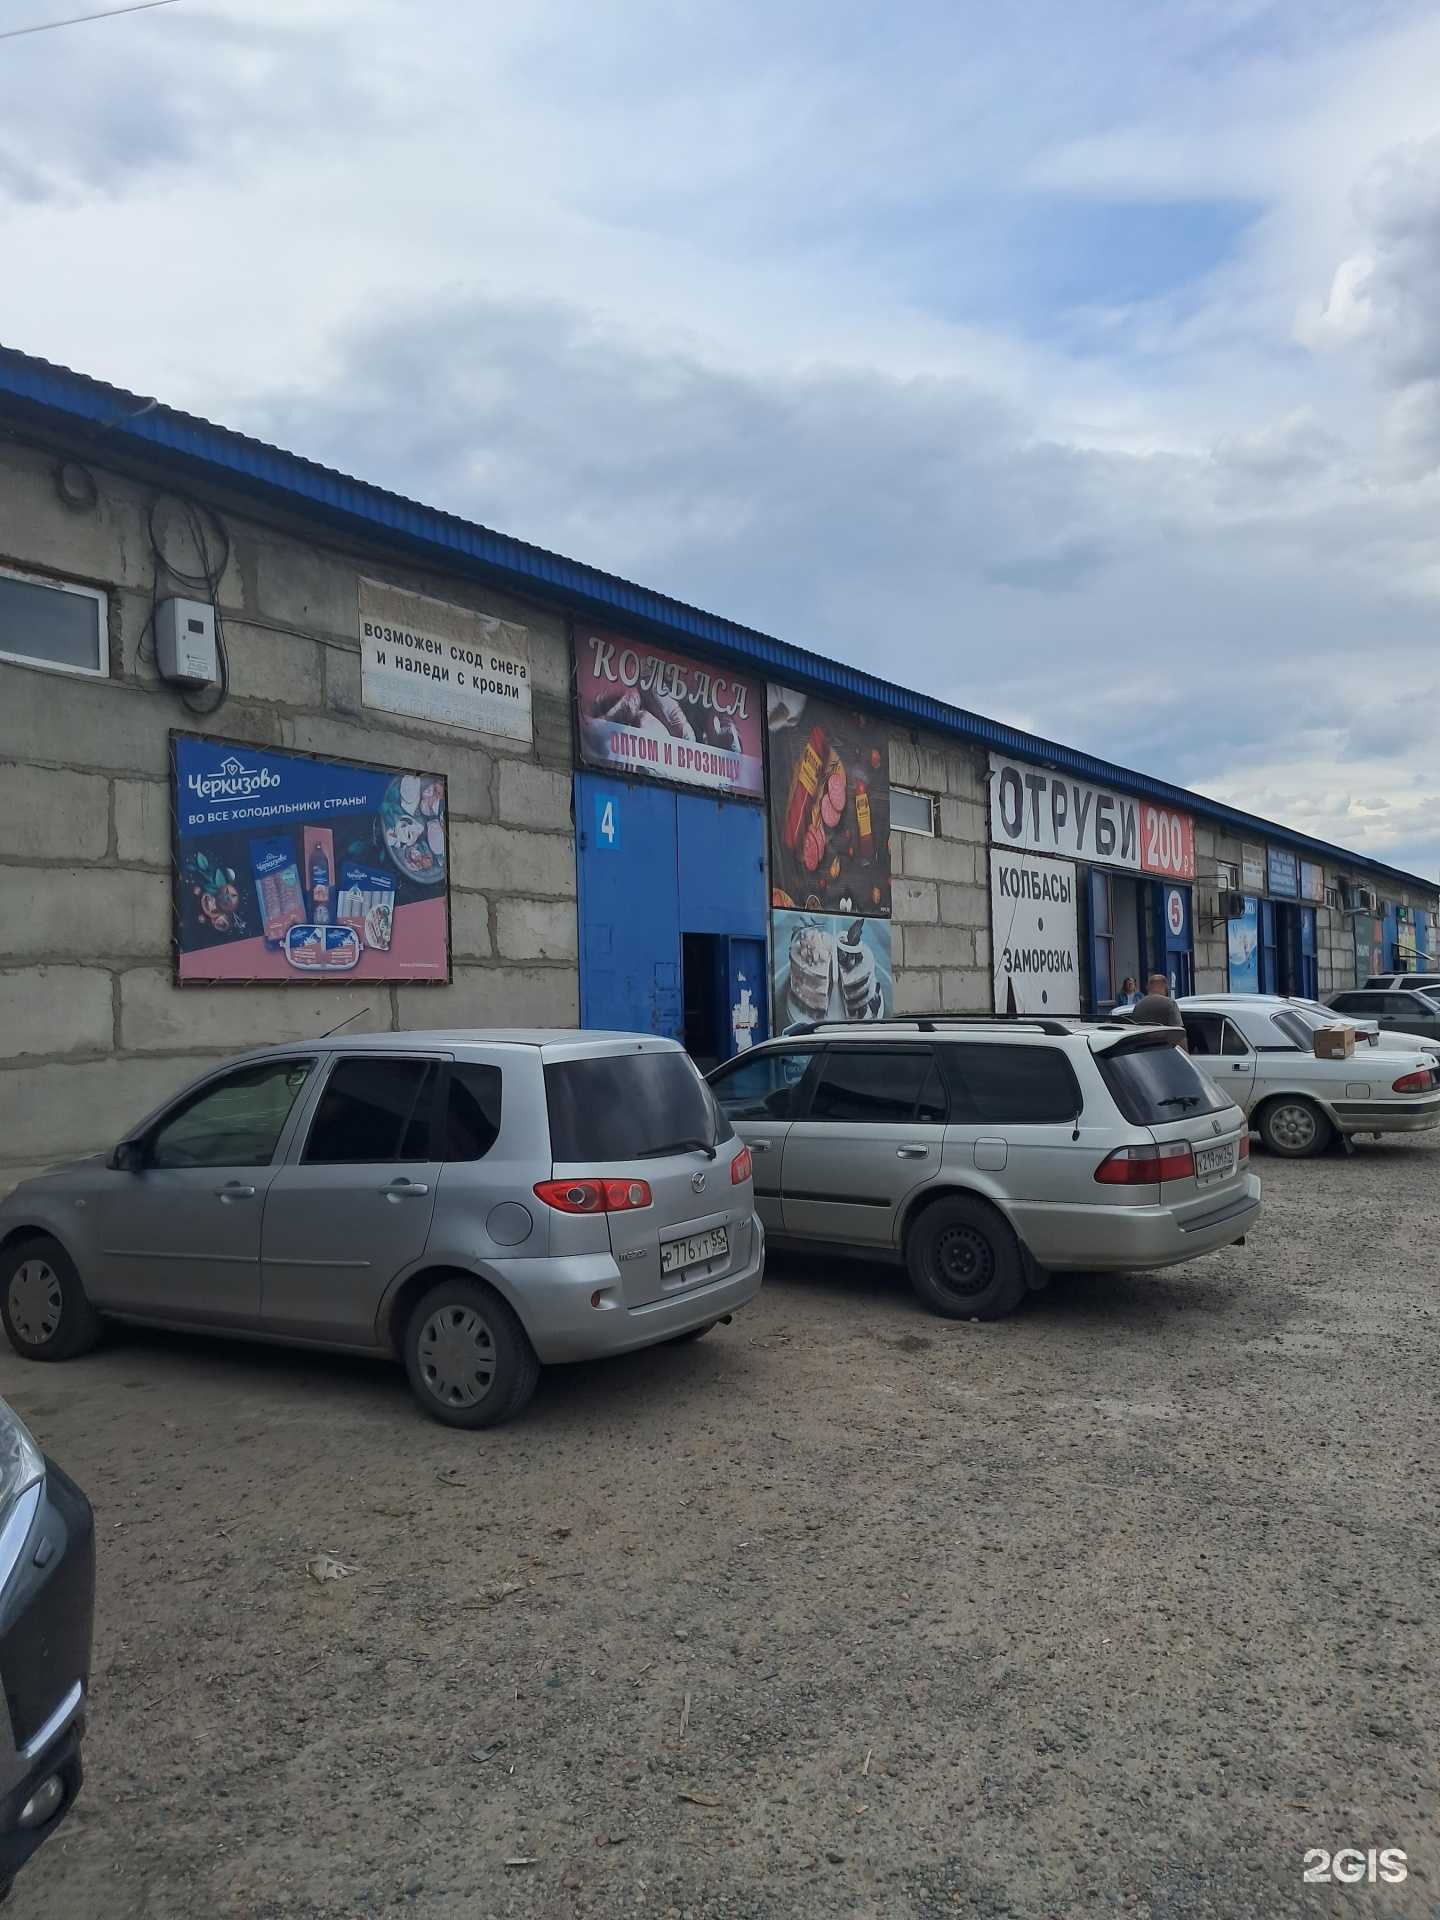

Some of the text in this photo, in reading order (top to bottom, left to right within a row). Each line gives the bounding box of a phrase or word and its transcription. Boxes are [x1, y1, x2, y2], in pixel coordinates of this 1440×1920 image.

[364, 622, 527, 679] возможен сход снега
[395, 656, 449, 681] наледи
[472, 675, 519, 699] кровли
[588, 636, 749, 720] КОЛБАСА
[609, 731, 740, 782] ОПТОМ И ВРОЗНИЦУ
[188, 768, 281, 798] Черкизово
[188, 795, 367, 825] ВО ВСЕ ХОЛОДИЛЬНИКИ СТРАНЫ!
[601, 801, 615, 843] 4
[999, 766, 1137, 861] ОТРУБИ
[1147, 807, 1183, 872] 200
[999, 866, 1071, 904] КОЛБАСЫ
[1171, 897, 1181, 928] 5
[1003, 949, 1074, 974] ЗАМОРОЗКА
